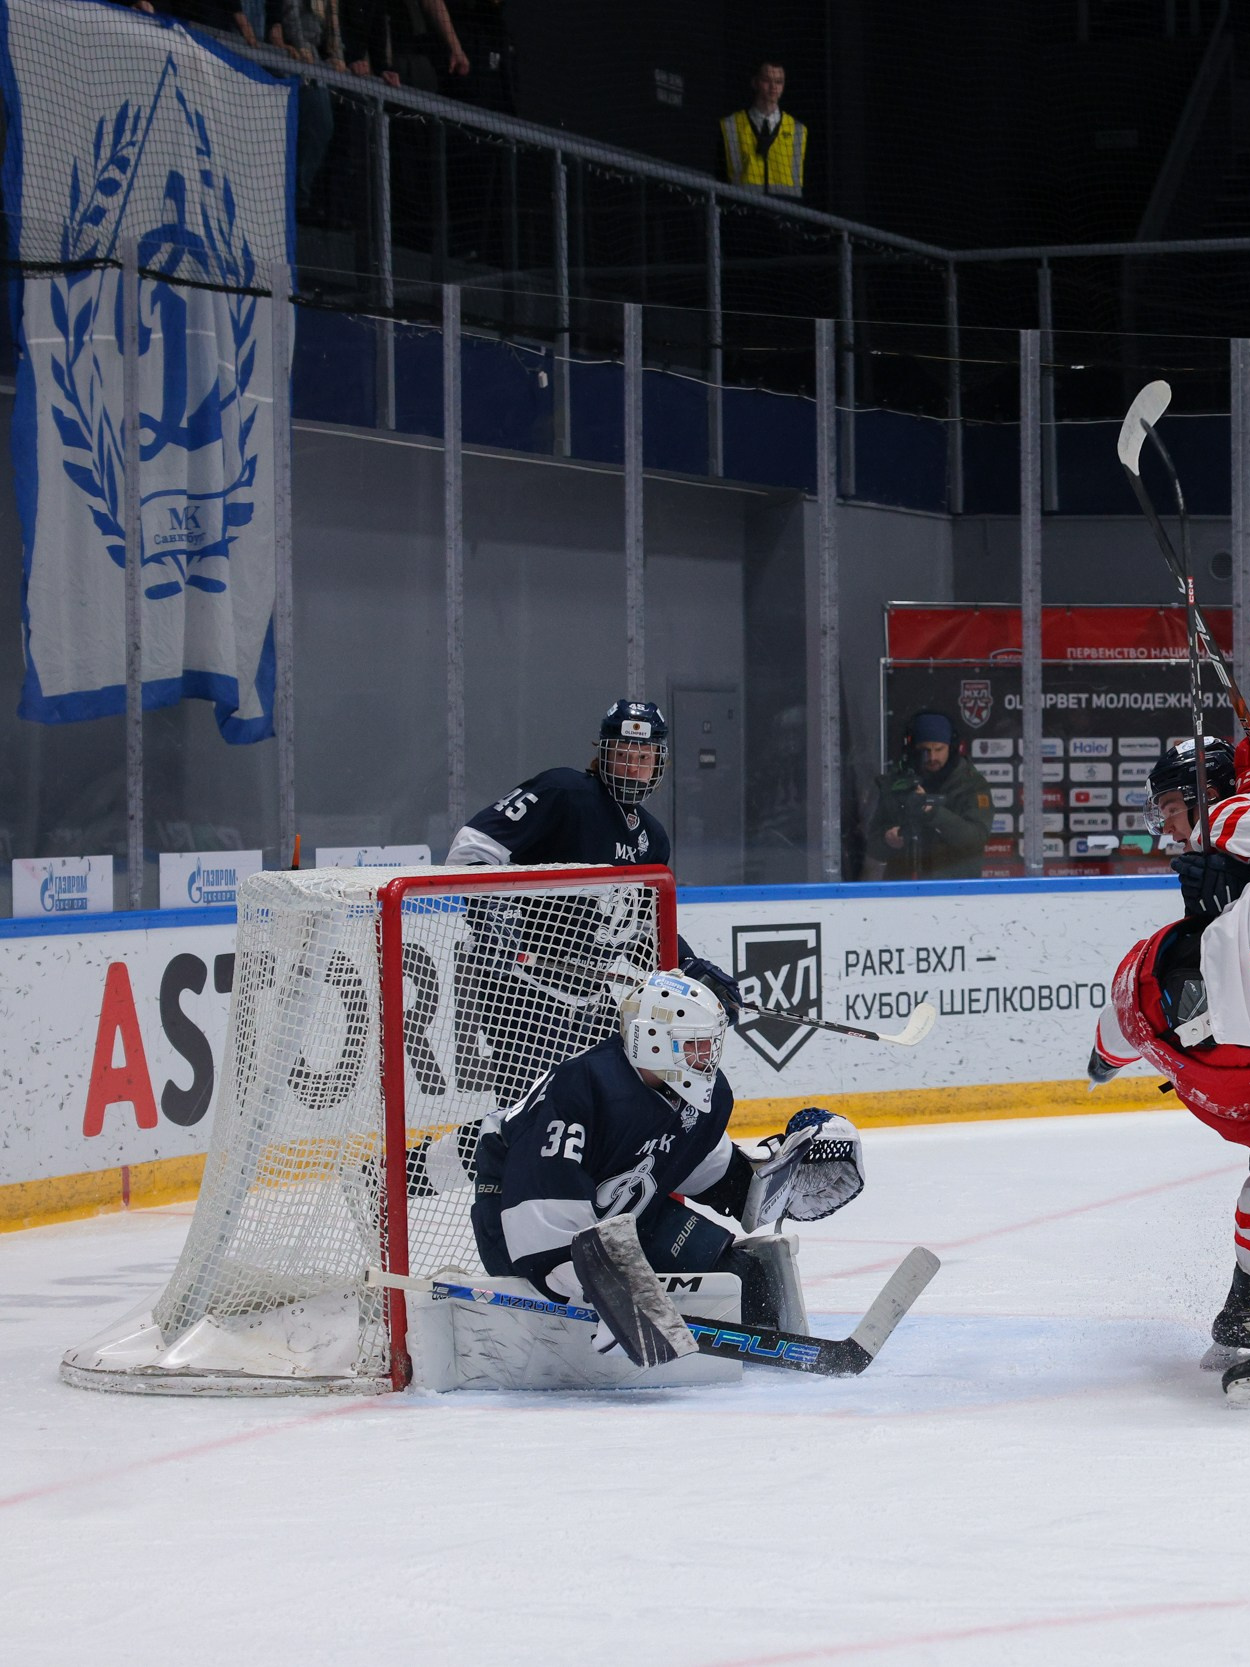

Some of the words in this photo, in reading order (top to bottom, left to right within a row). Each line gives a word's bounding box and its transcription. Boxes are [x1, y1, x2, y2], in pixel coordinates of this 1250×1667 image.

[1066, 647, 1148, 660] ПЕРВЕНСТВО
[629, 703, 646, 711] 45
[1092, 692, 1213, 711] МОЛОДЕЖНЯ
[1073, 741, 1108, 754] Haier
[493, 787, 539, 822] 45
[615, 842, 637, 864] МХ
[54, 875, 88, 894] ГАЗПРОМ
[845, 949, 905, 977] PARI
[917, 946, 966, 974] ВХЛ
[738, 955, 818, 1024] ВХЛ
[940, 982, 1106, 1017] ШЕЛКОВОГО
[632, 1024, 640, 1059] BAUER
[541, 1120, 586, 1164] 32
[477, 1182, 502, 1194] BAU
[671, 1214, 700, 1258] BAUER
[500, 1295, 568, 1316] HZRDUS
[686, 1323, 821, 1364] TRUE
